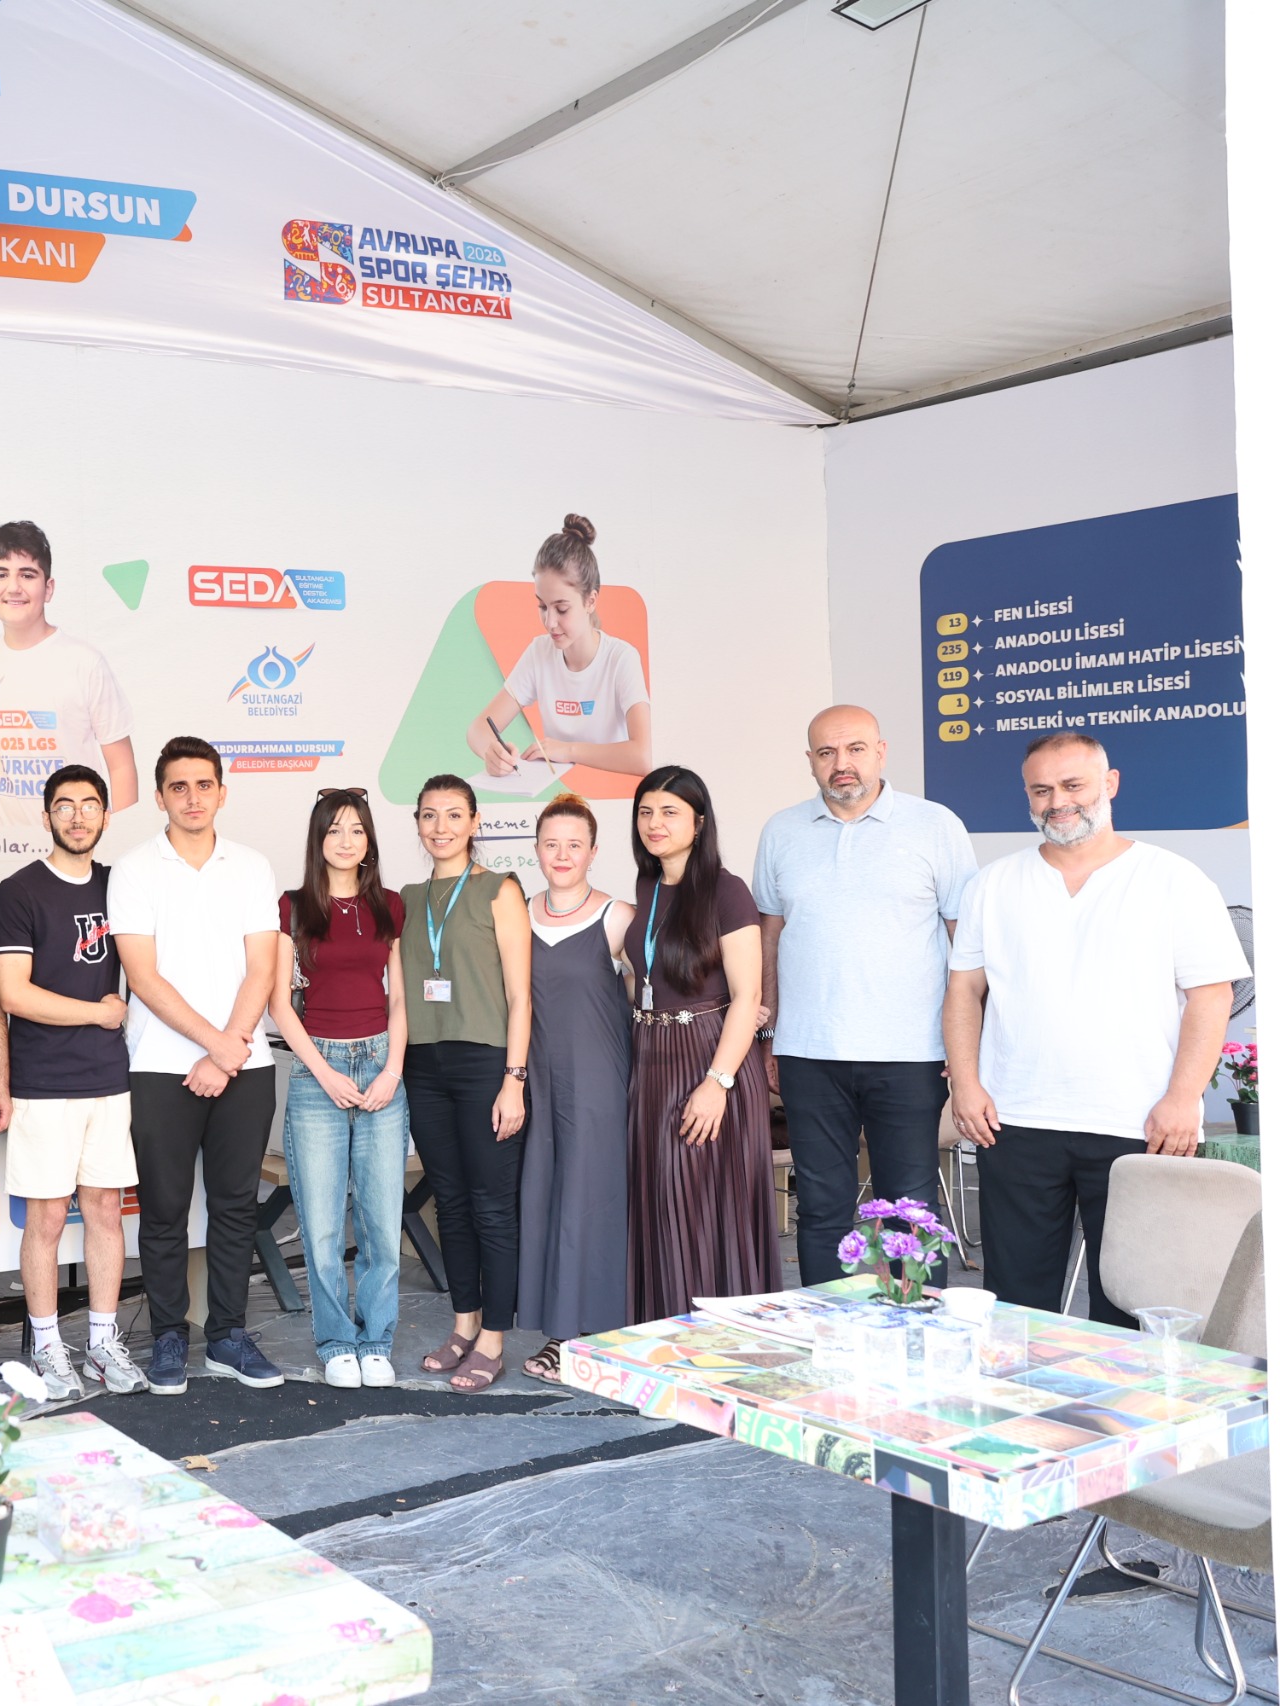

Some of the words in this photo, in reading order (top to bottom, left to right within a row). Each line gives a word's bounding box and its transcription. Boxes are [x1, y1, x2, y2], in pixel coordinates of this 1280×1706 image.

[2, 183, 161, 226] DURSUN
[358, 227, 462, 260] AVRUPA
[466, 245, 502, 263] 2026
[359, 256, 428, 285] SPOR
[436, 264, 512, 293] ŞEHRİ
[366, 287, 507, 316] SULTANGAZİ
[193, 571, 307, 608] SEDA
[949, 617, 961, 629] 13
[994, 607, 1023, 623] FEN
[1026, 595, 1073, 618] LİSESİ
[941, 644, 962, 655] 235
[995, 629, 1072, 650] ANADOLU
[1075, 618, 1125, 641] LİSESİ
[943, 671, 962, 682] 119
[995, 657, 1072, 677] ANADOLU
[1075, 652, 1125, 670] İMAM
[1128, 642, 1182, 665] HATİP
[1184, 634, 1241, 659] LİSESİ
[242, 692, 303, 705] SULTANGAZİ
[956, 698, 963, 708] 1
[995, 688, 1055, 705] SOSYAL
[1057, 679, 1134, 699] BİLİMLER
[1137, 670, 1191, 693] LİSESİ
[248, 705, 298, 717] BELEDİYESİ
[948, 725, 964, 735] 49
[996, 710, 1063, 732] MESLEKİ
[1065, 716, 1085, 728] ve
[1087, 704, 1152, 726] TEKNİK
[1154, 701, 1246, 721] ANADOLU
[28, 738, 57, 750] LGS
[295, 744, 335, 753] DURSUN
[236, 759, 276, 769] BELEDİYE
[277, 759, 313, 770] BAŞKANI
[486, 856, 512, 867] LGS
